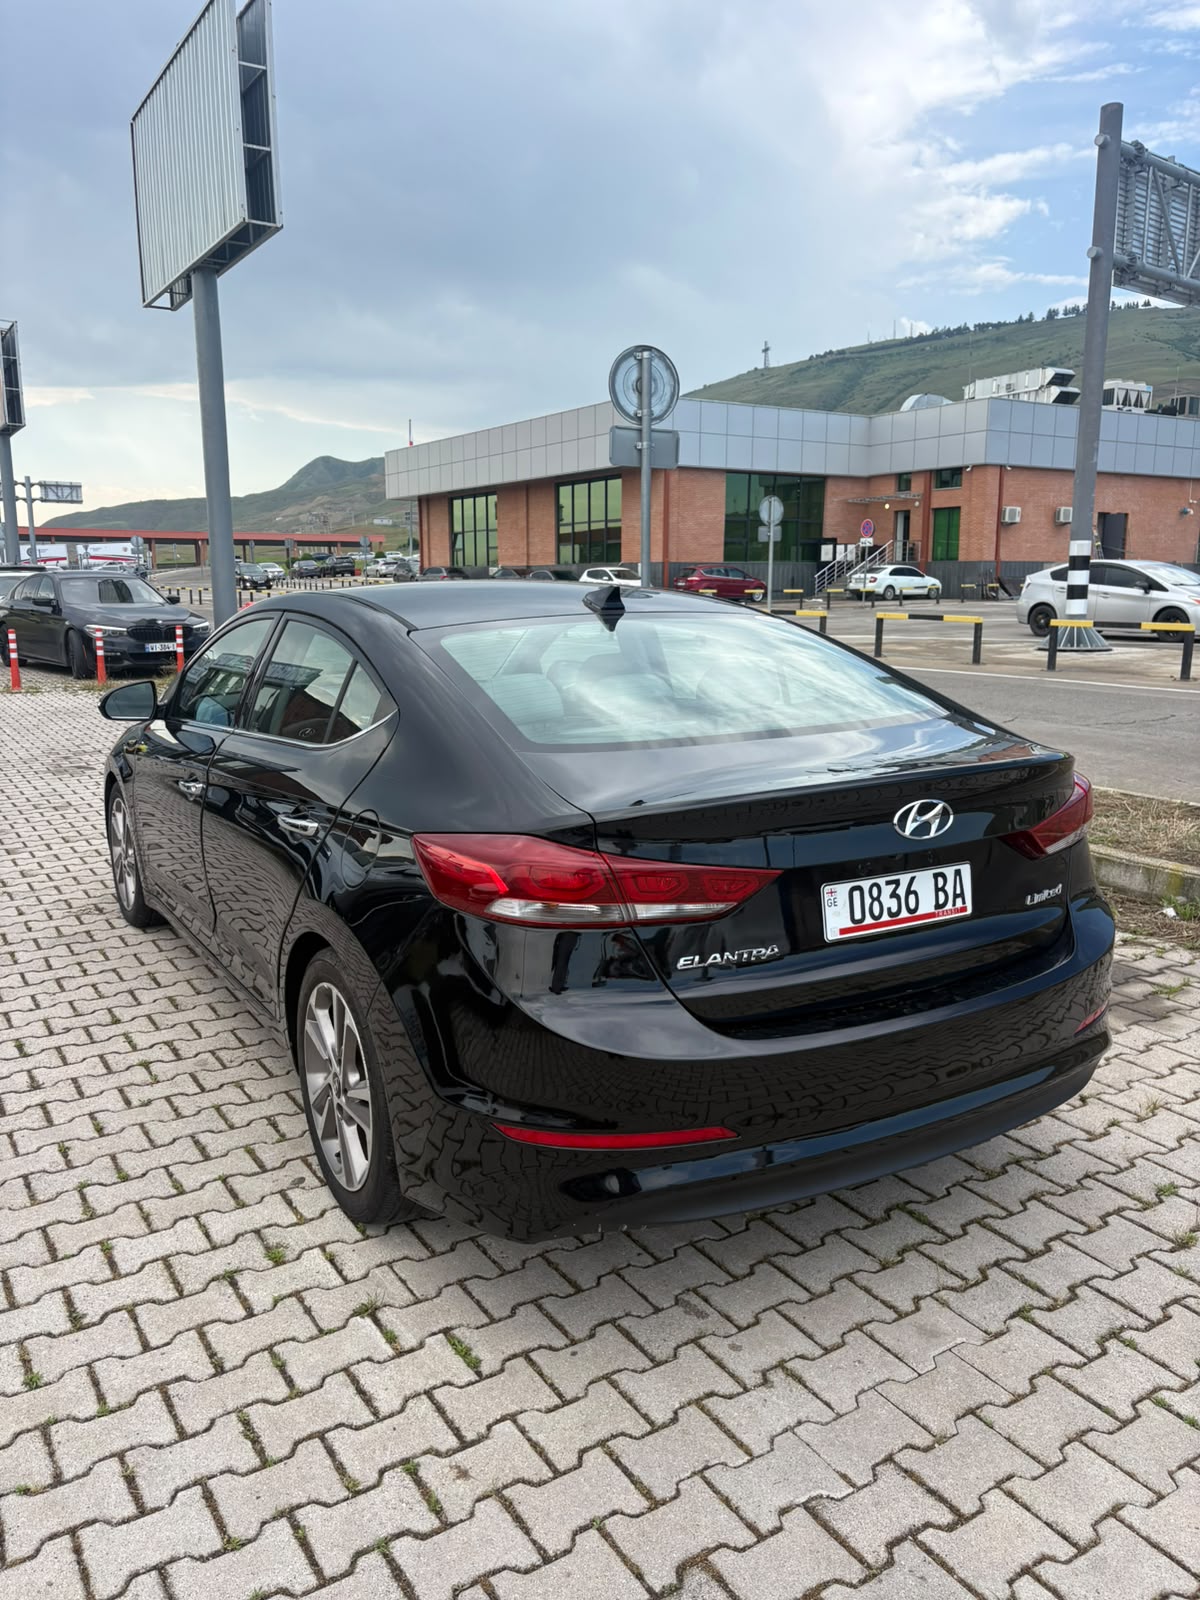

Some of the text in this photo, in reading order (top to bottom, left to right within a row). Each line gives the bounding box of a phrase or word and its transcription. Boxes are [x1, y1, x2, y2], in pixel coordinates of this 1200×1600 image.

[826, 896, 838, 908] GE
[848, 868, 967, 925] 0836 BA
[676, 944, 780, 970] ELANTRA
